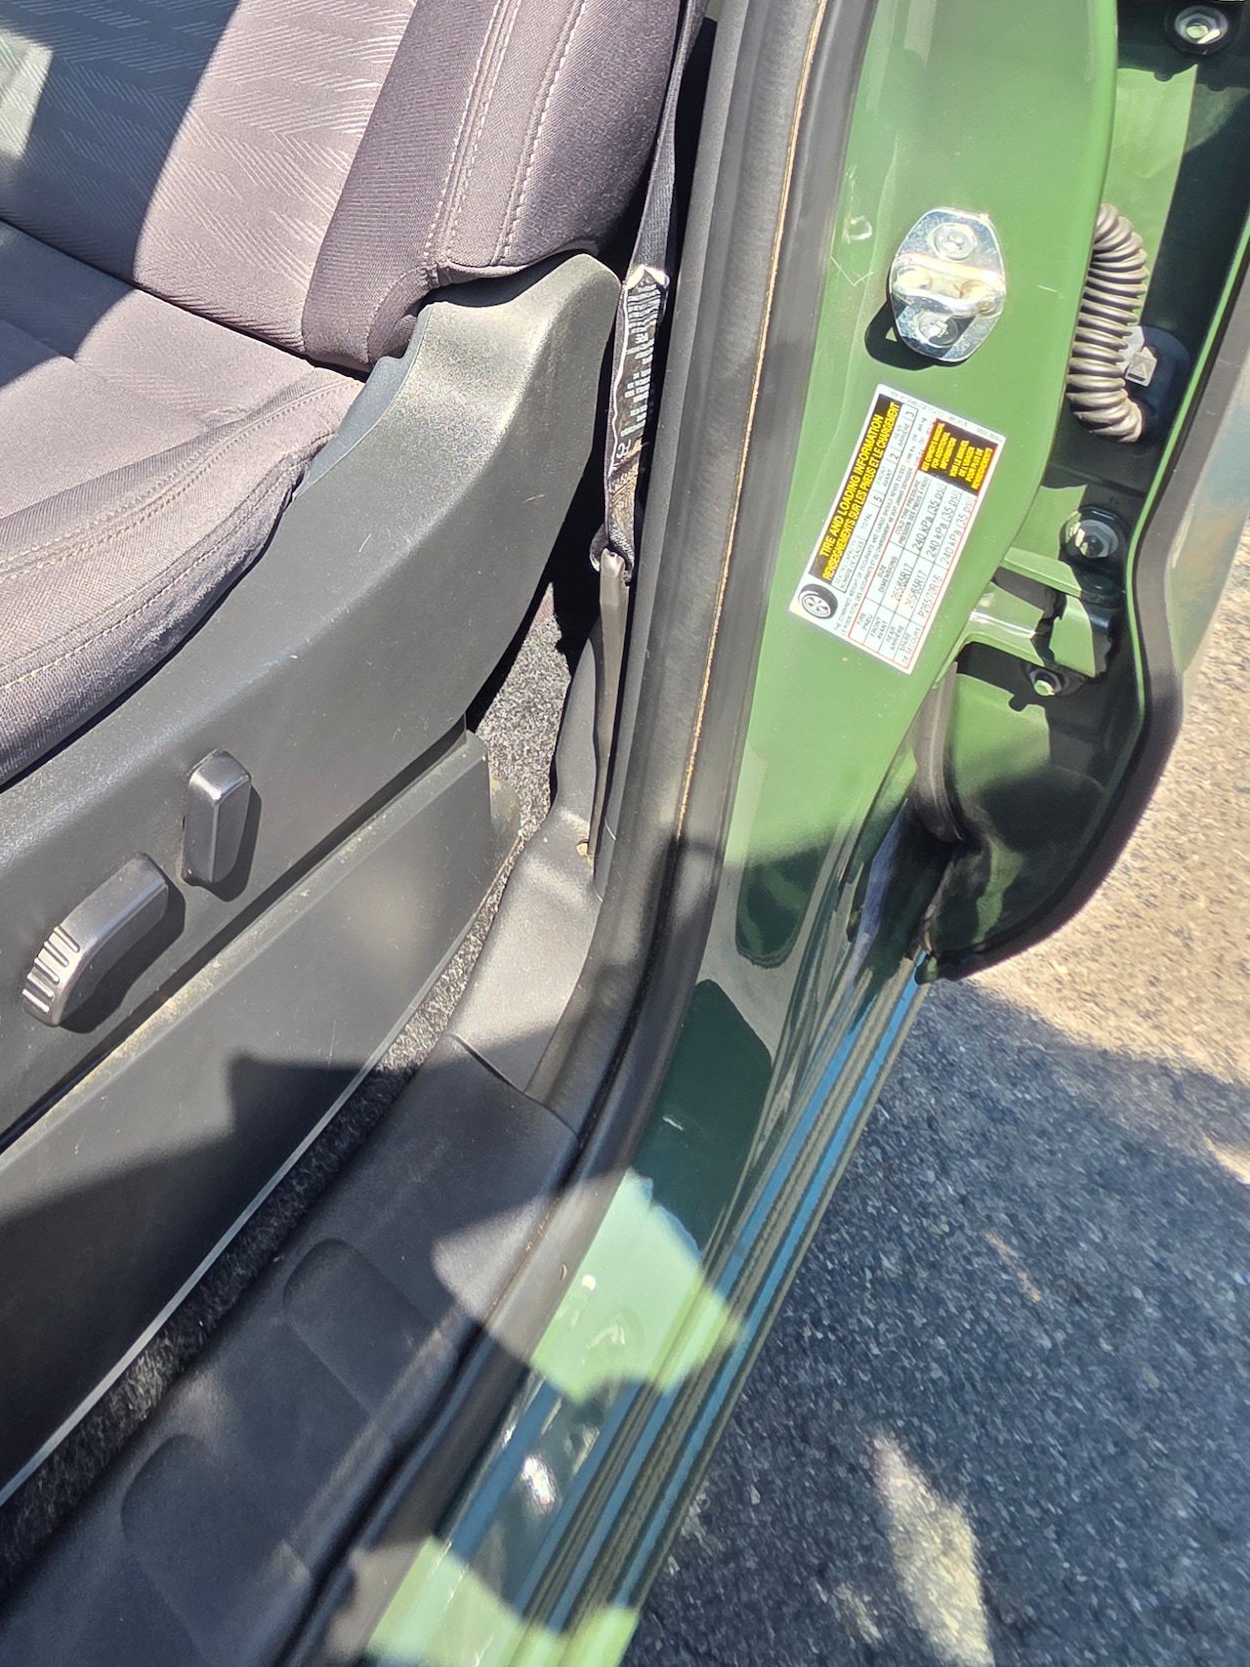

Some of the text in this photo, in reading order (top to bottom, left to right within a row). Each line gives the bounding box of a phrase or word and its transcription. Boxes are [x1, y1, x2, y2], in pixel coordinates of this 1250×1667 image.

[889, 452, 898, 460] 2
[818, 413, 884, 558] TIRE AND LOADING INFORMATION
[822, 401, 901, 581] RENSEIGNEMENTS SUR LES PNEUS ET LE CHARGEMENT
[872, 494, 882, 502] 5
[926, 498, 941, 516] (35
[940, 505, 955, 522] (35
[954, 512, 969, 529] (35
[918, 514, 933, 533] kPa
[932, 521, 947, 539] kPa
[911, 532, 926, 551] 240
[946, 527, 961, 546] kPa
[925, 539, 940, 558] 240
[939, 546, 954, 565] 240
